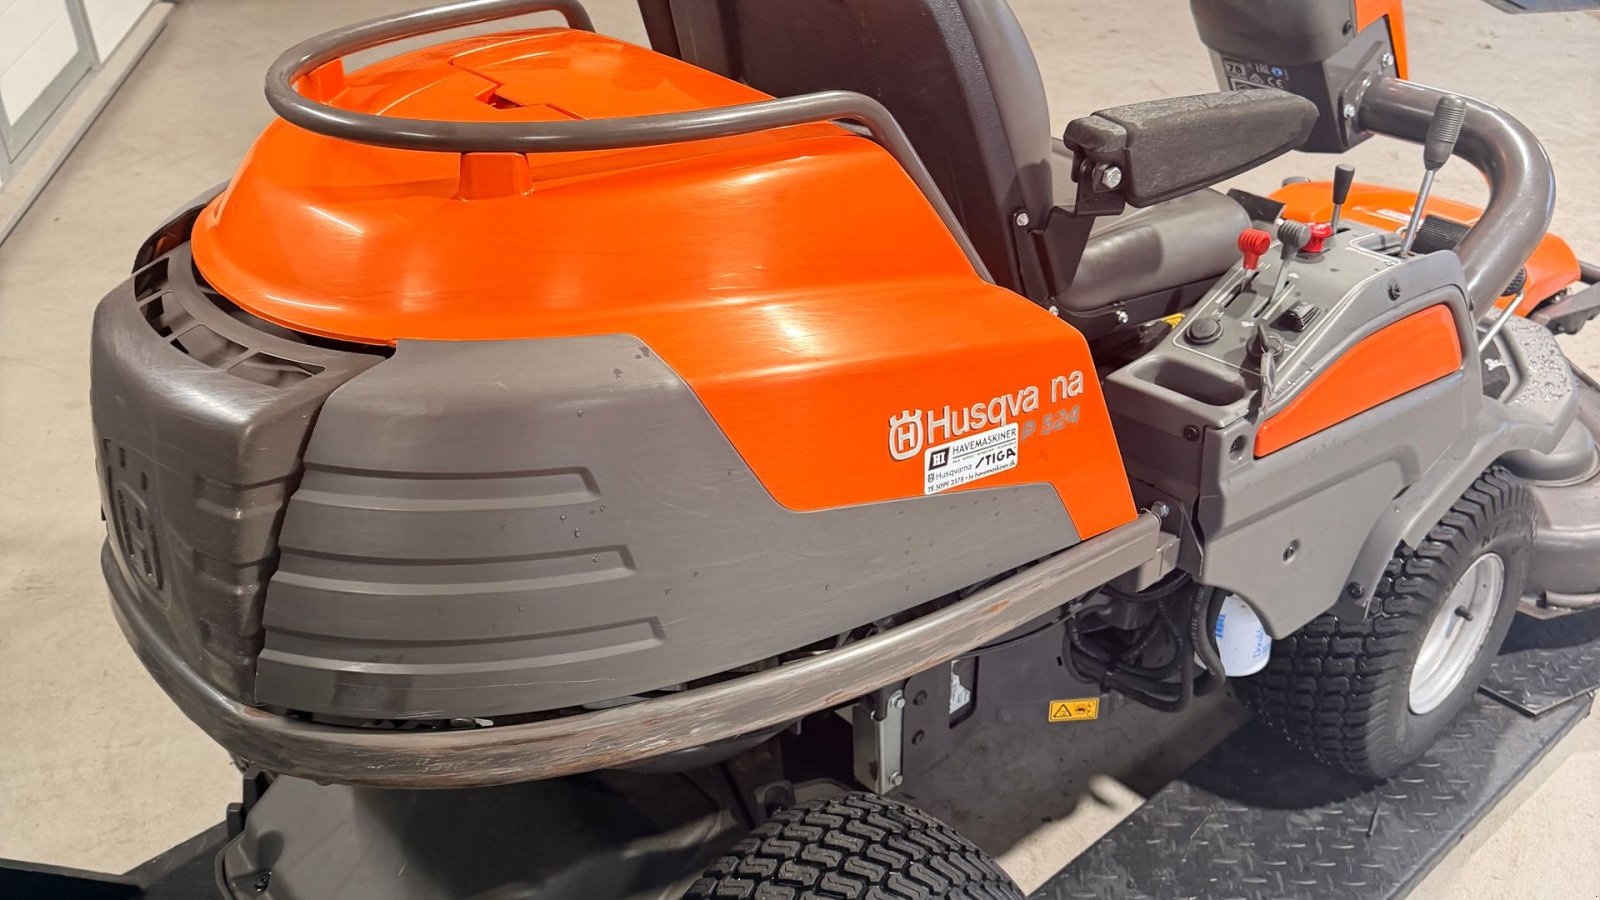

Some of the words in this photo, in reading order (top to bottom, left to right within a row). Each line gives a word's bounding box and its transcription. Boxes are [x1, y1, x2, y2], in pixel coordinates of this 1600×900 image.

[1020, 419, 1037, 443] P
[1040, 404, 1080, 436] 524
[952, 428, 1017, 456] HAVEMASKINER
[975, 447, 1016, 469] STIGA
[935, 463, 973, 480] Husqvarna
